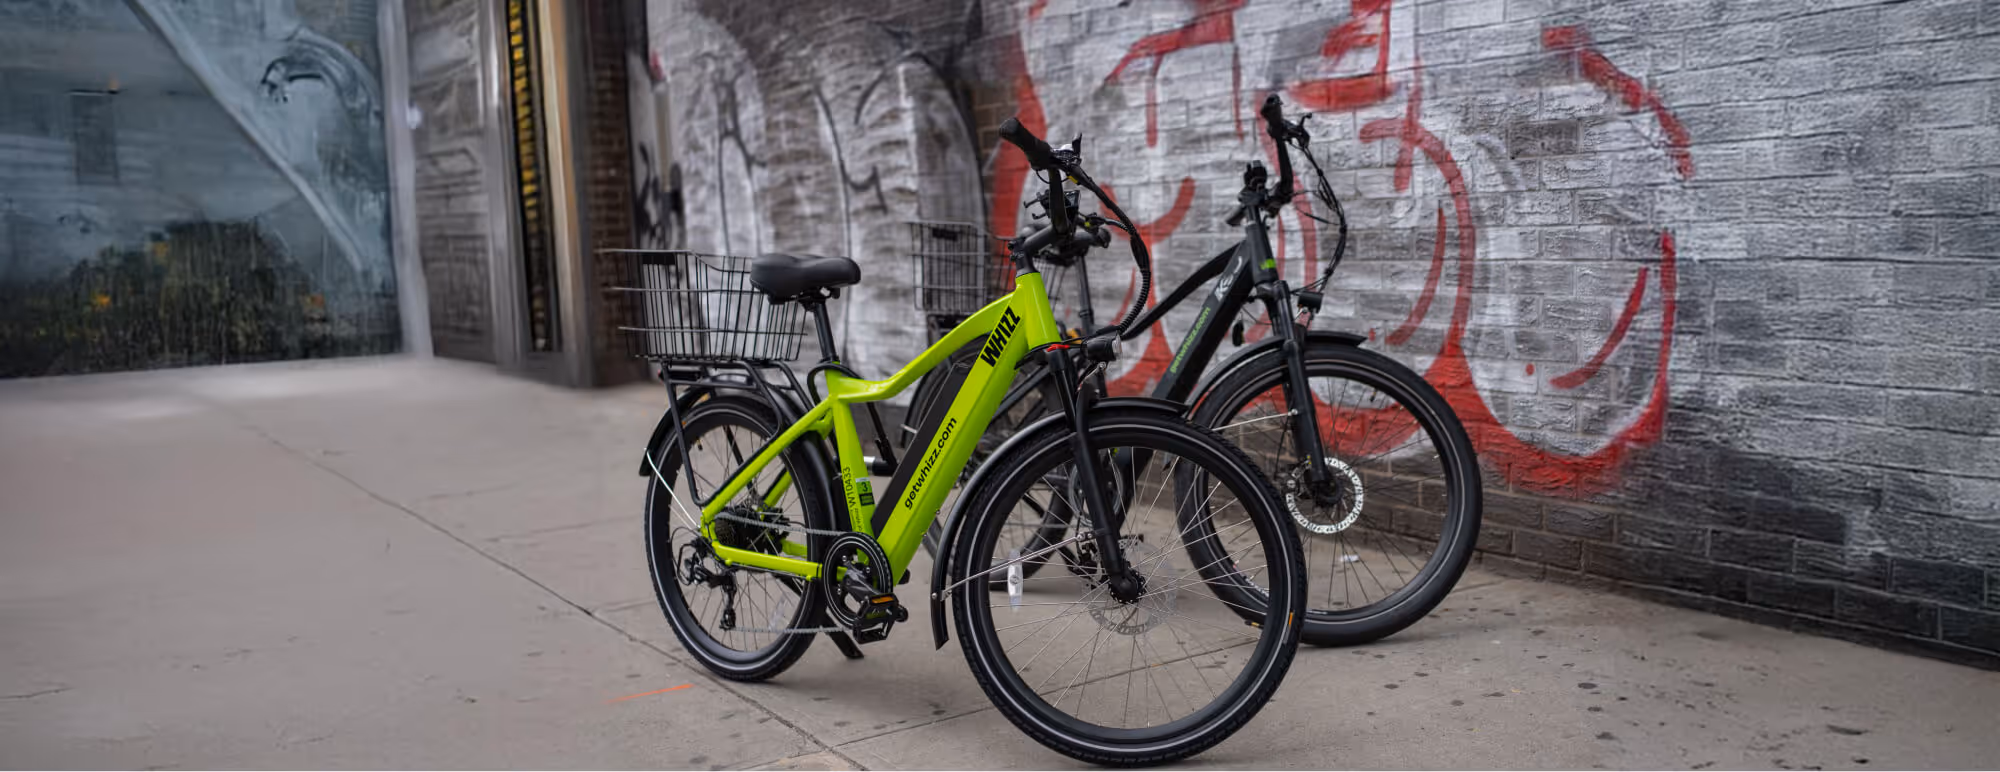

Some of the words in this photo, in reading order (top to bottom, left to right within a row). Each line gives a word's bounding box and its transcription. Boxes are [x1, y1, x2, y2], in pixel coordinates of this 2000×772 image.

[980, 306, 1021, 368] WHIZZ
[842, 466, 857, 507] W10433
[903, 416, 958, 511] getwhizz.com
